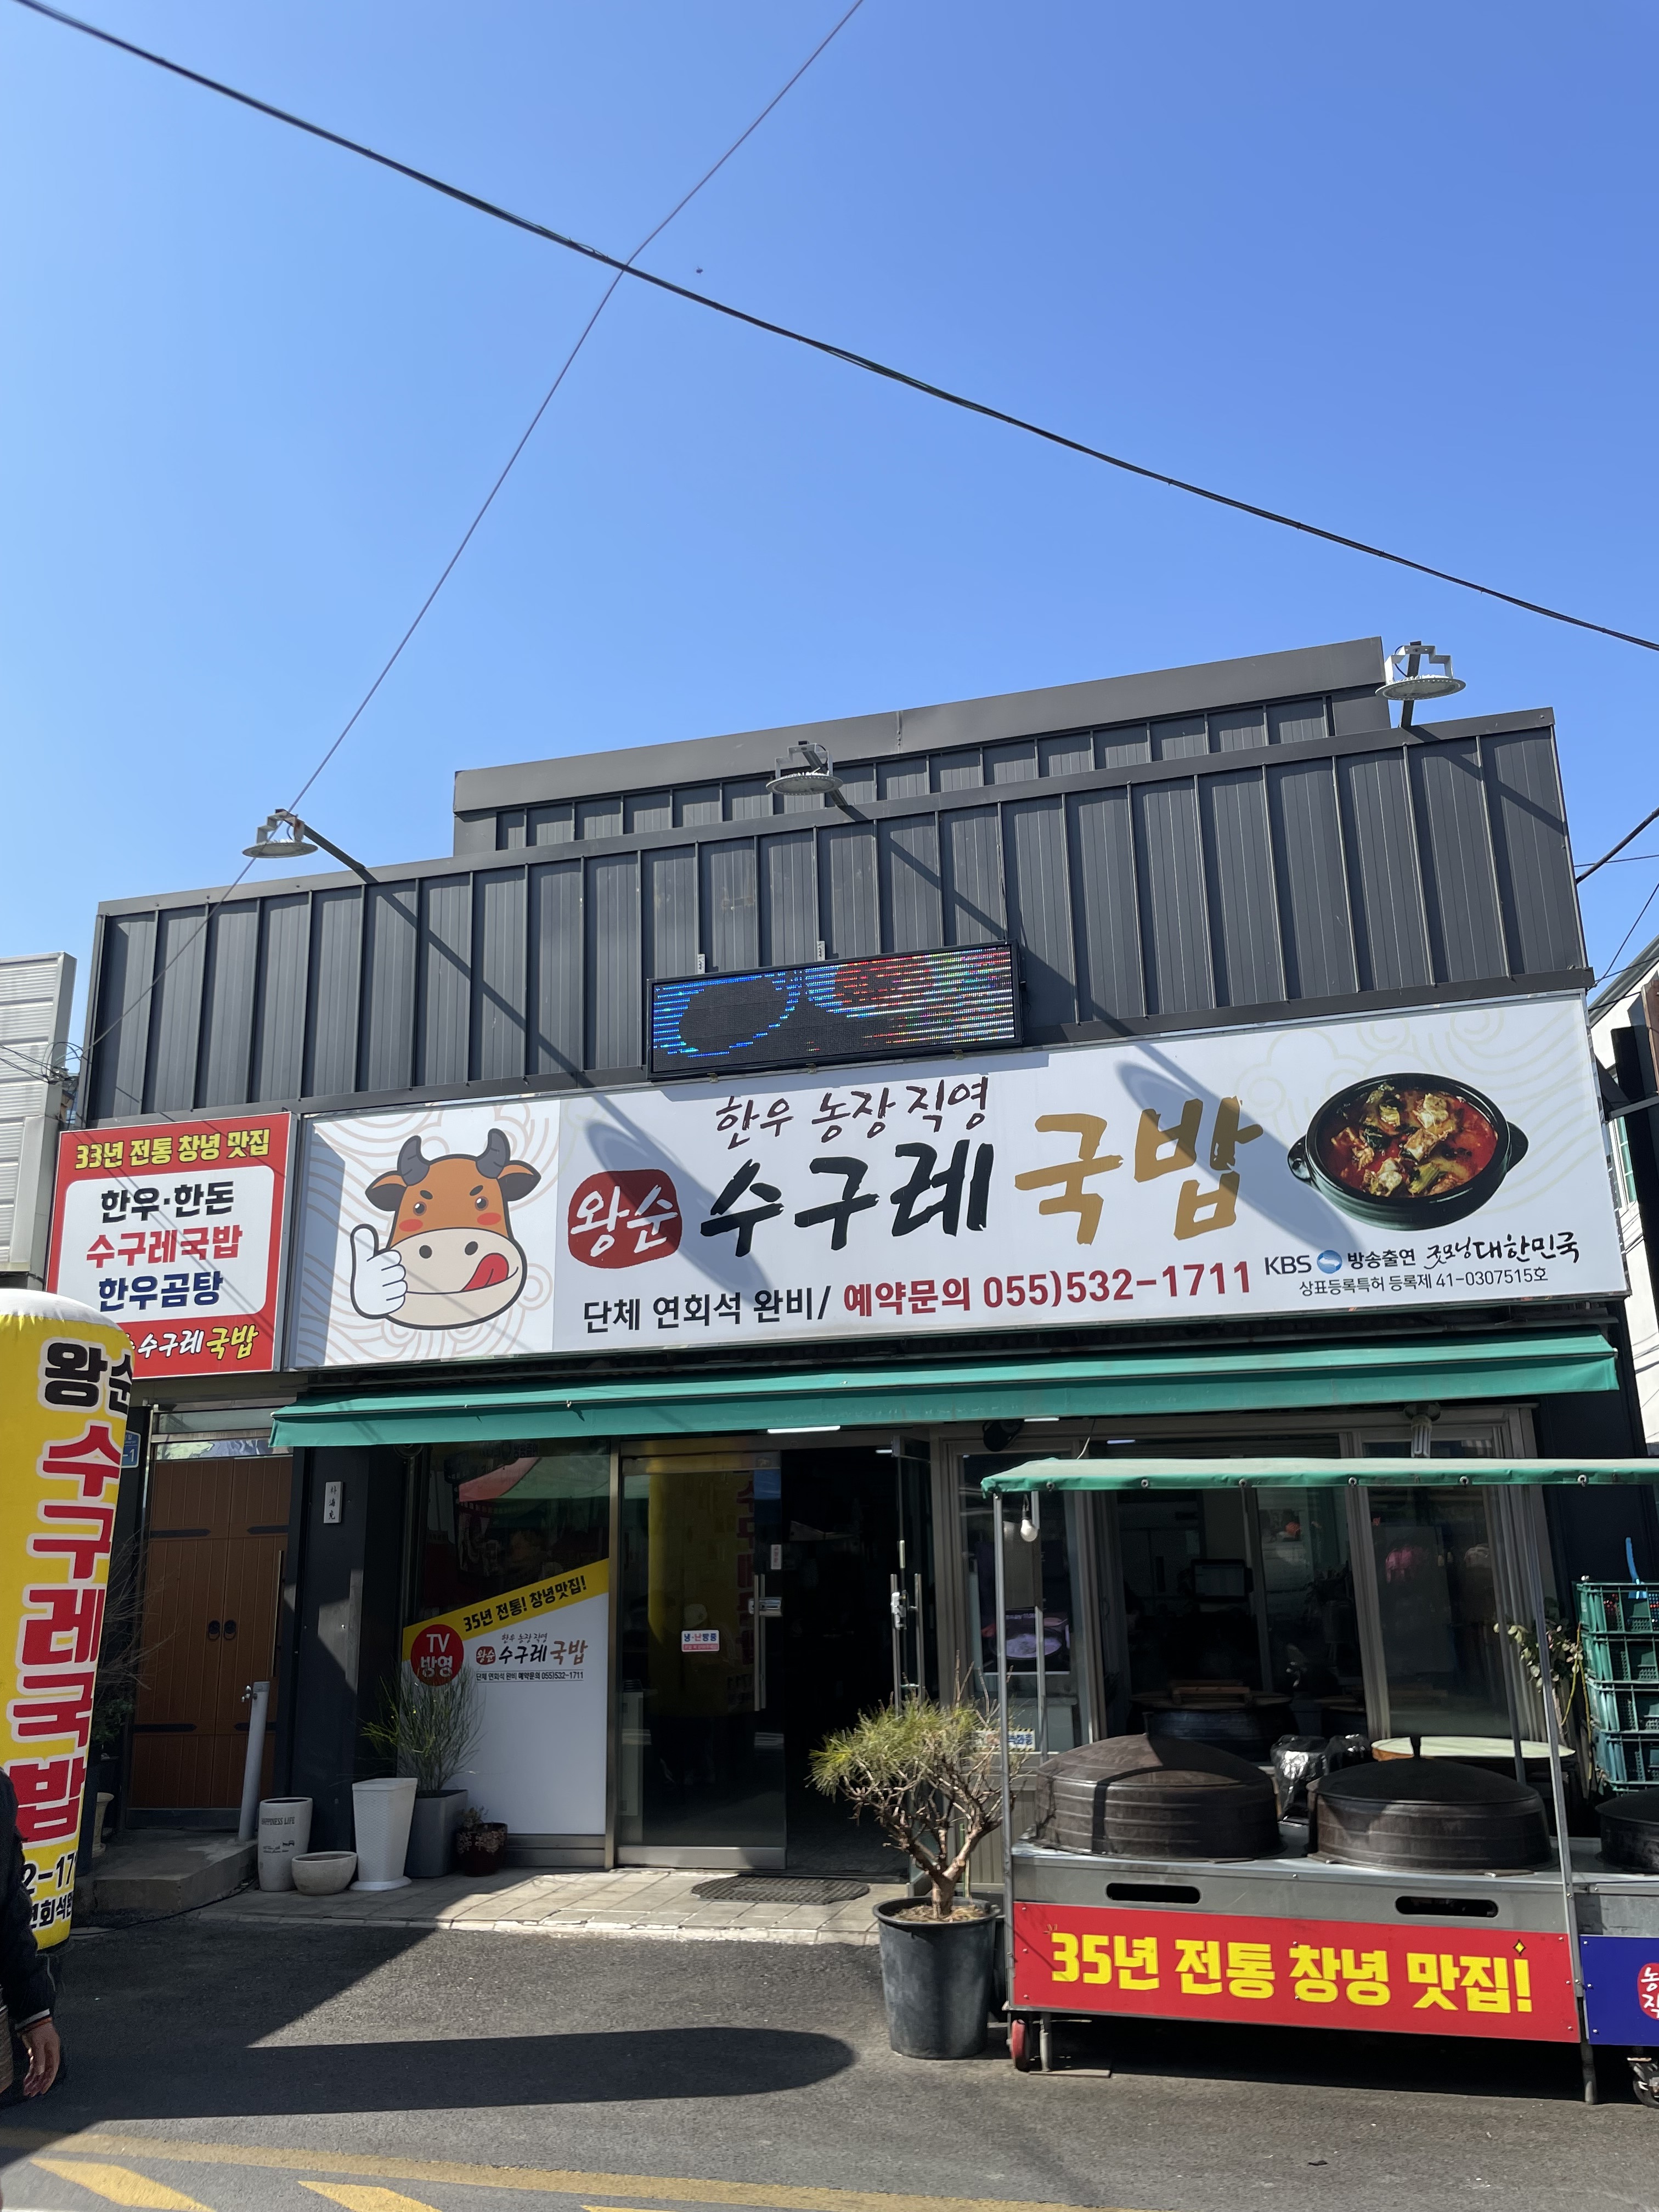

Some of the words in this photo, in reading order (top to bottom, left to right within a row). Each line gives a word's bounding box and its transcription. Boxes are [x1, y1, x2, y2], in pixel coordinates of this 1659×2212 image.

[716, 1096, 794, 1149] 한우
[812, 1087, 895, 1142] 농장
[905, 1076, 989, 1133] 직영
[75, 1141, 123, 1169] 33년
[129, 1136, 172, 1165] 전통
[178, 1132, 221, 1163] 창녕
[226, 1128, 270, 1159] 맛집
[571, 1185, 678, 1257] 왕순
[701, 1139, 994, 1257] 수구레
[1015, 1096, 1263, 1245] 국밥
[101, 1181, 234, 1223] 한우·한돈
[87, 1224, 242, 1268] 수구레국밥
[1347, 1249, 1415, 1269] 방송출연
[1265, 1255, 1312, 1276] KBS
[1300, 1278, 1384, 1296] 상표등록특허
[1389, 1273, 1431, 1289] 등록제
[1436, 1266, 1548, 1288] 41-0307515호
[99, 1271, 223, 1312] 한우곰탕
[584, 1298, 641, 1333] 단체
[653, 1291, 741, 1329] 연회석
[844, 1277, 970, 1317] 예약문의
[983, 1261, 1250, 1308] 055)532-1711
[138, 1329, 204, 1359] 수구레
[206, 1324, 259, 1360] 국밥
[464, 1608, 493, 1632] 35년
[496, 1596, 527, 1621] 전통!
[426, 1633, 450, 1652] TV
[477, 1650, 495, 1664] 왕순
[498, 1645, 548, 1664] 수구레
[550, 1640, 588, 1666] 국밥
[501, 1633, 515, 1644] 한우
[518, 1633, 532, 1644] 농장
[533, 1632, 548, 1643] 직영
[421, 1656, 453, 1678] 방영
[476, 1672, 487, 1681] 단체
[488, 1672, 504, 1680] 연회석
[506, 1672, 517, 1680] 완비
[518, 1672, 540, 1680] 예약문의
[541, 1671, 583, 1681] 055)532-1711
[1051, 1932, 1160, 1990] 35년
[1175, 1938, 1275, 2000] 전통
[1289, 1944, 1391, 2006] 창녕
[1406, 1952, 1533, 2014] 맛집!
